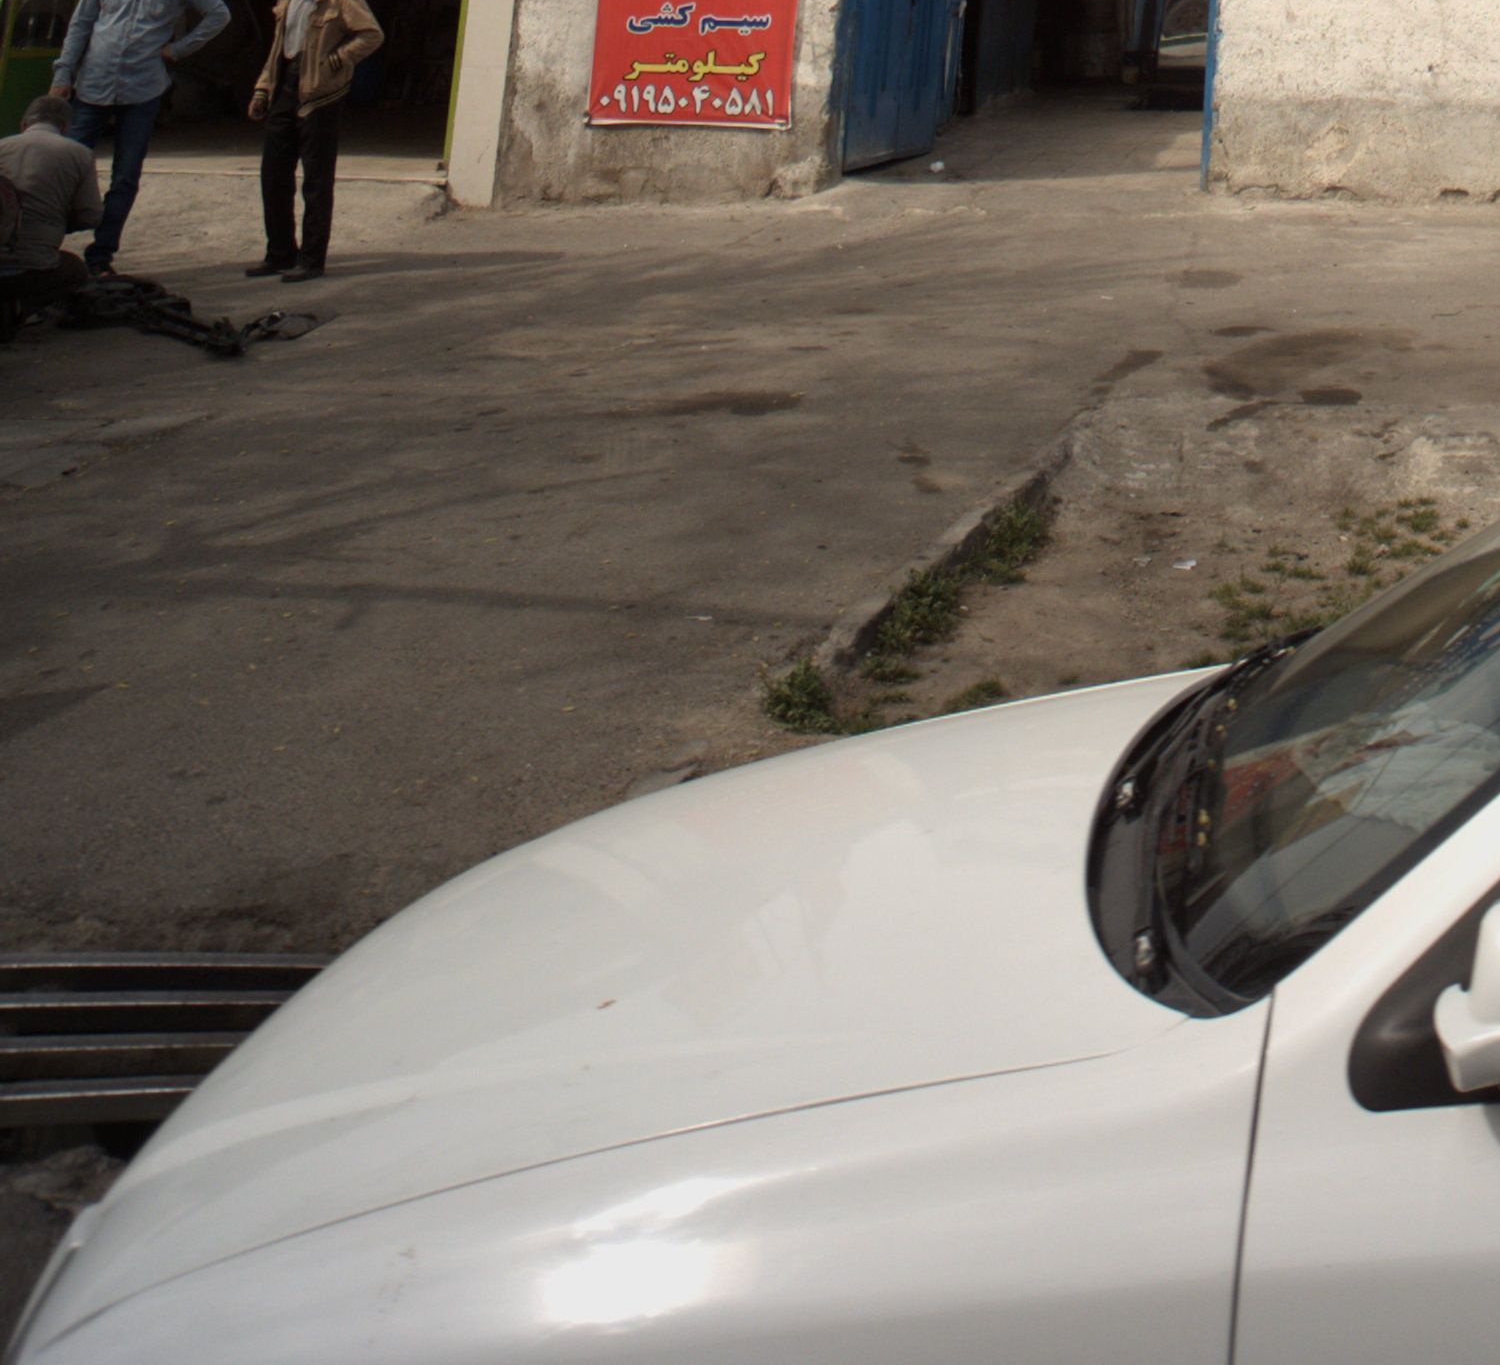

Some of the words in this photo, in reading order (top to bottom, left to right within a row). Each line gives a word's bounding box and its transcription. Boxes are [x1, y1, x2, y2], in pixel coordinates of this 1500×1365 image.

[626, 2, 697, 34] کشی
[699, 14, 772, 36] سیم
[623, 50, 766, 82] کیلومتر
[599, 83, 775, 117] ۰۹۱۹۵۰۴۰۵۸۱
